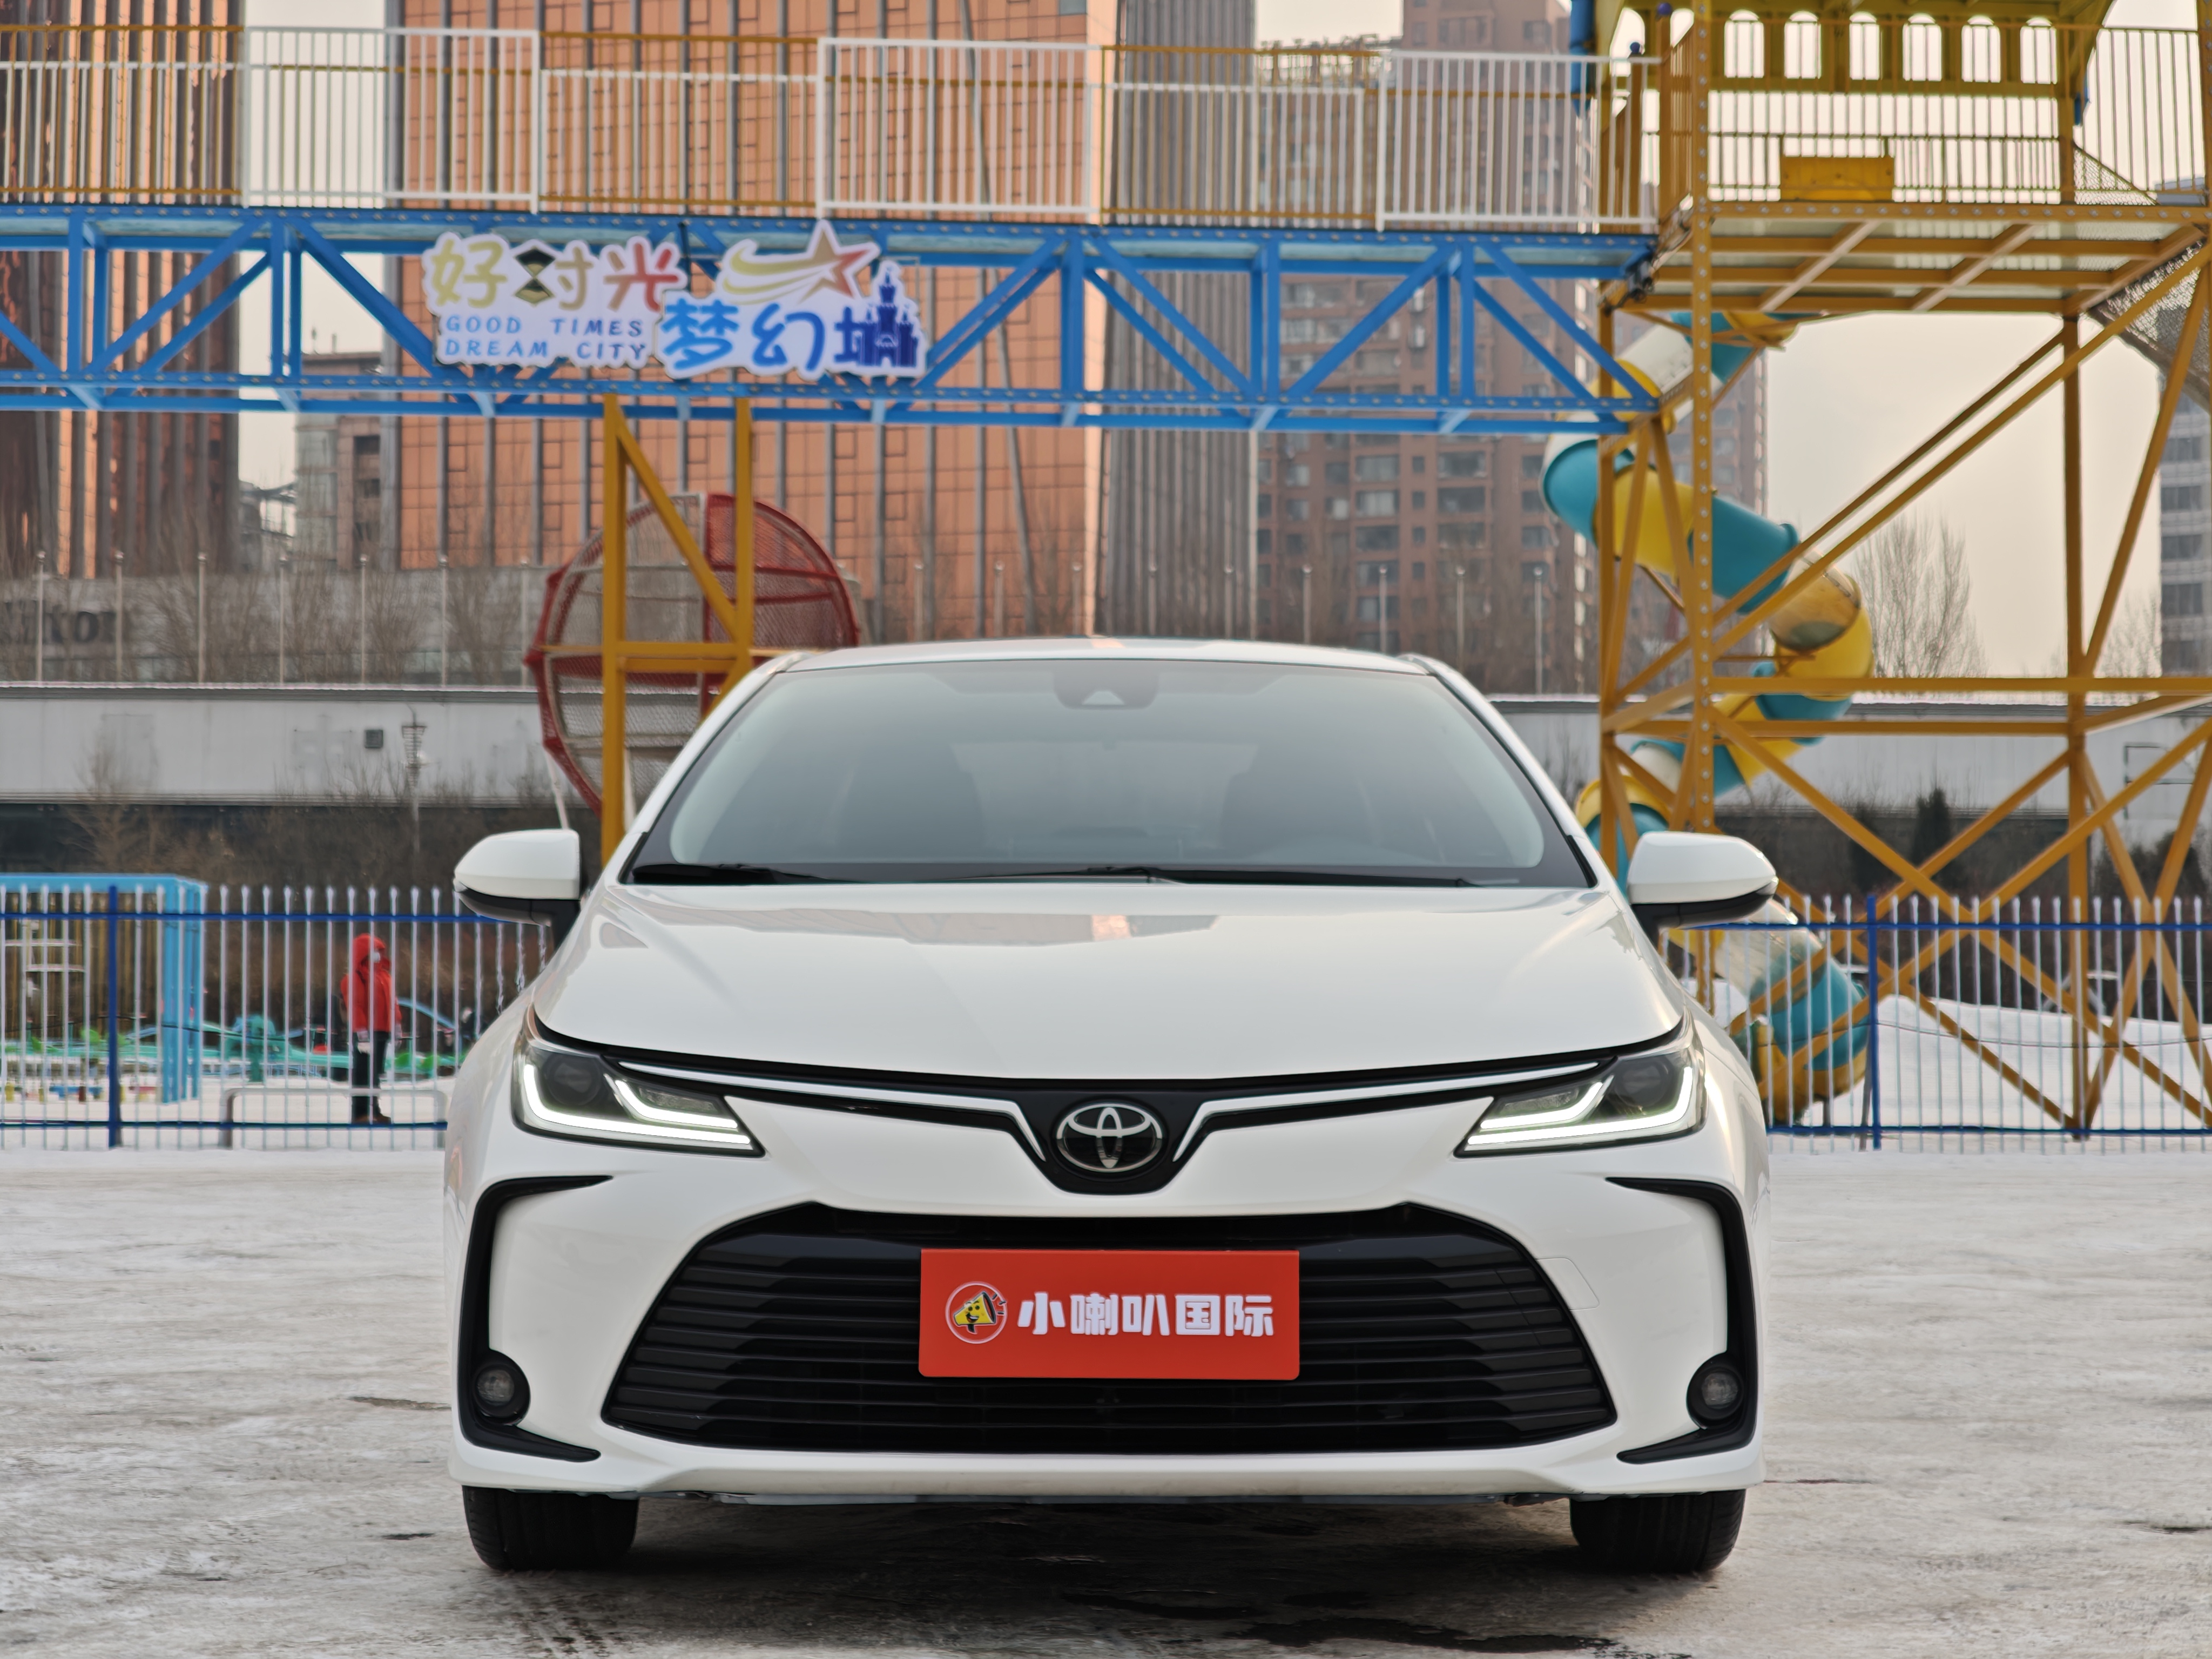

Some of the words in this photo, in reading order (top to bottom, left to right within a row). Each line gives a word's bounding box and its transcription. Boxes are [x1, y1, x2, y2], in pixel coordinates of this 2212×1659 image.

[446, 316, 521, 333] GOOD
[550, 318, 643, 336] TIMES
[446, 339, 548, 358] DREAM
[577, 342, 645, 360] CITY
[1019, 1292, 1273, 1337] 小喇叭国际
